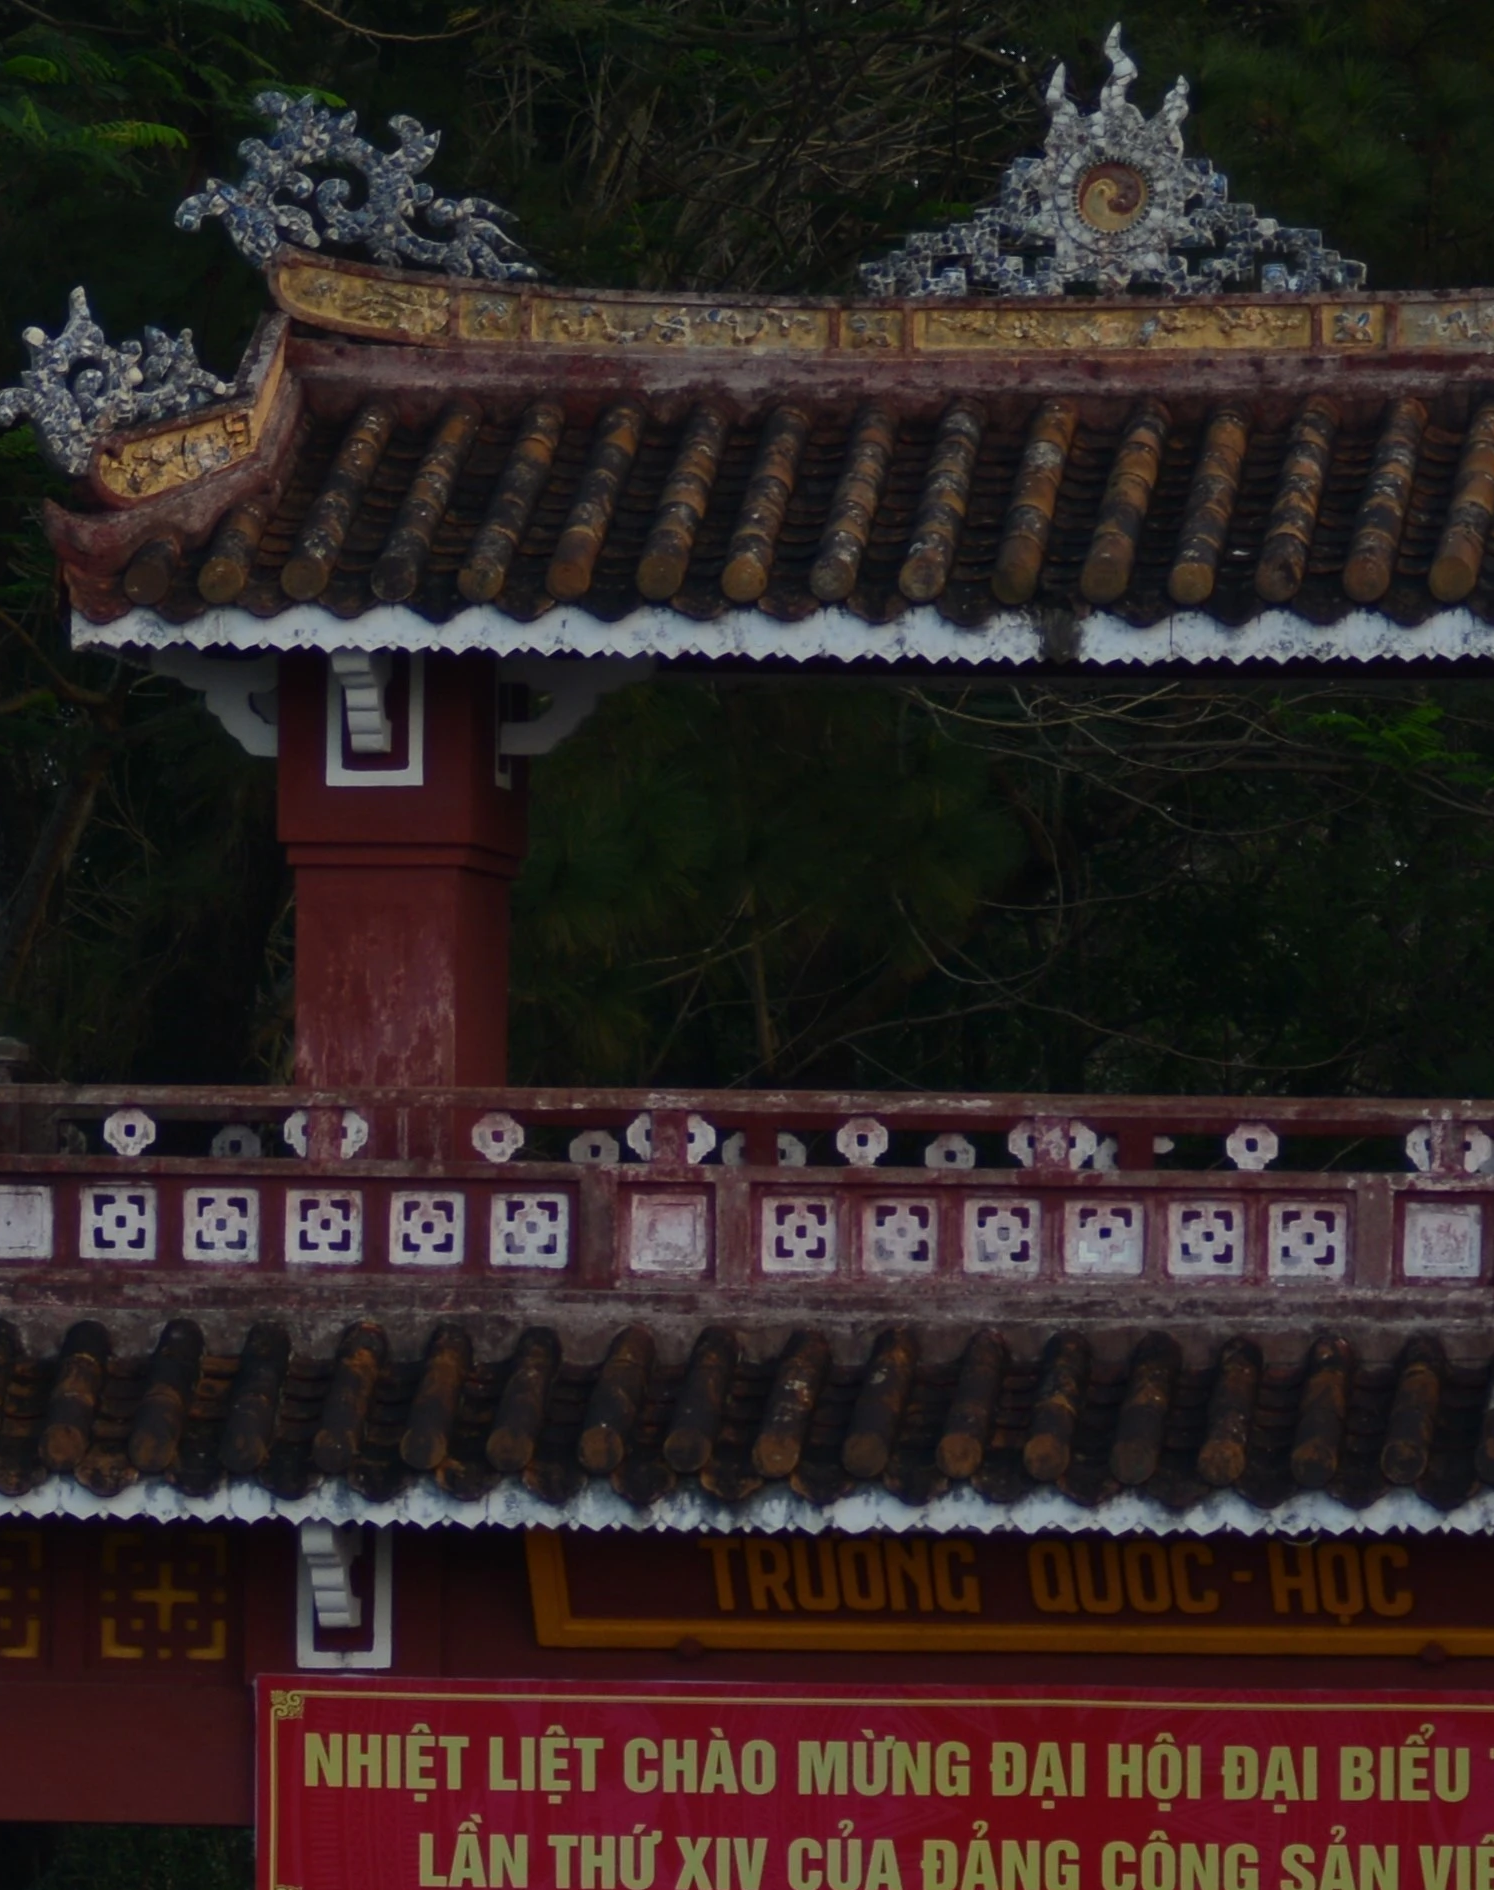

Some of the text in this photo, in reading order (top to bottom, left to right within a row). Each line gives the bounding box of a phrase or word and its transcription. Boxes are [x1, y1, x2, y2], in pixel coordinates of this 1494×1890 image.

[304, 1723, 470, 1803] NHIỆT
[488, 1725, 605, 1804] LIỆT
[623, 1727, 777, 1795] CHÀO
[797, 1729, 971, 1797] MỪNG
[989, 1741, 1086, 1810] ĐẠI
[1107, 1732, 1202, 1812] HỘI
[1221, 1745, 1318, 1814] ĐẠI
[1339, 1723, 1470, 1803] BIỂU
[418, 1814, 529, 1889] LẦN
[547, 1824, 663, 1890] THỨ
